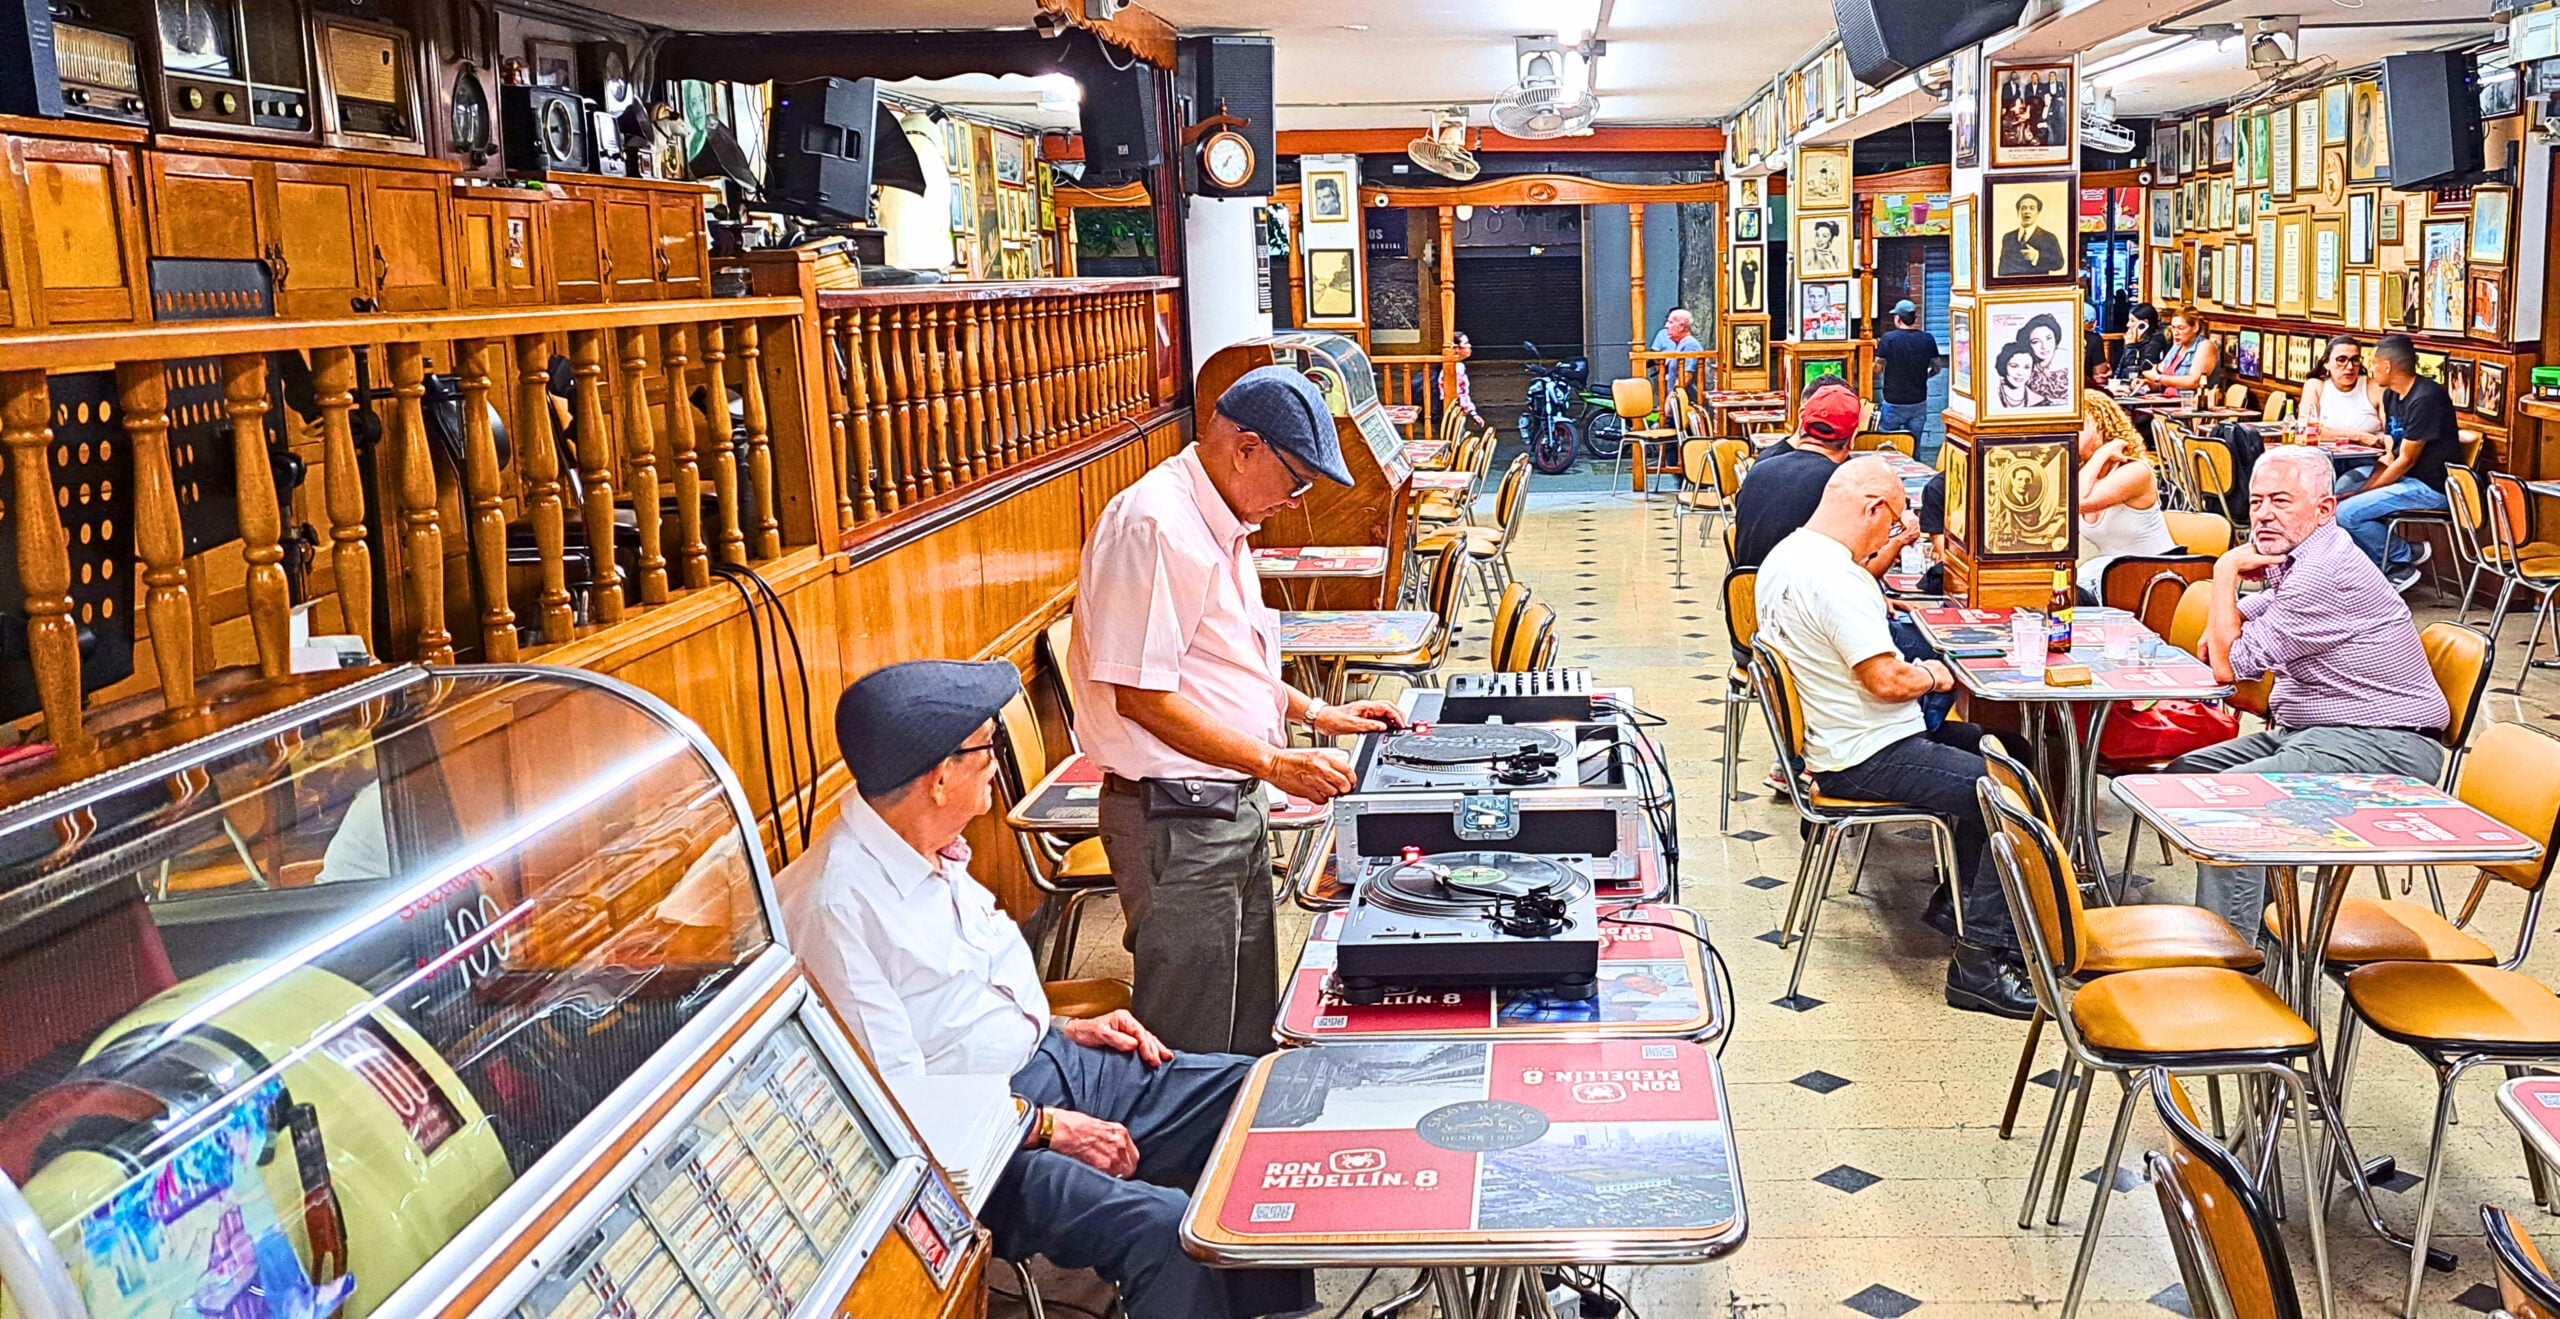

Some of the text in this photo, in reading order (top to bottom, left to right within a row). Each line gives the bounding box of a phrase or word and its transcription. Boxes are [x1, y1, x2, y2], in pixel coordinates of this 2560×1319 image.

[1522, 1070, 1544, 1085] 8
[1631, 1080, 1682, 1092] RON
[1266, 1162, 1322, 1176] RON
[1414, 1168, 1439, 1188] 8
